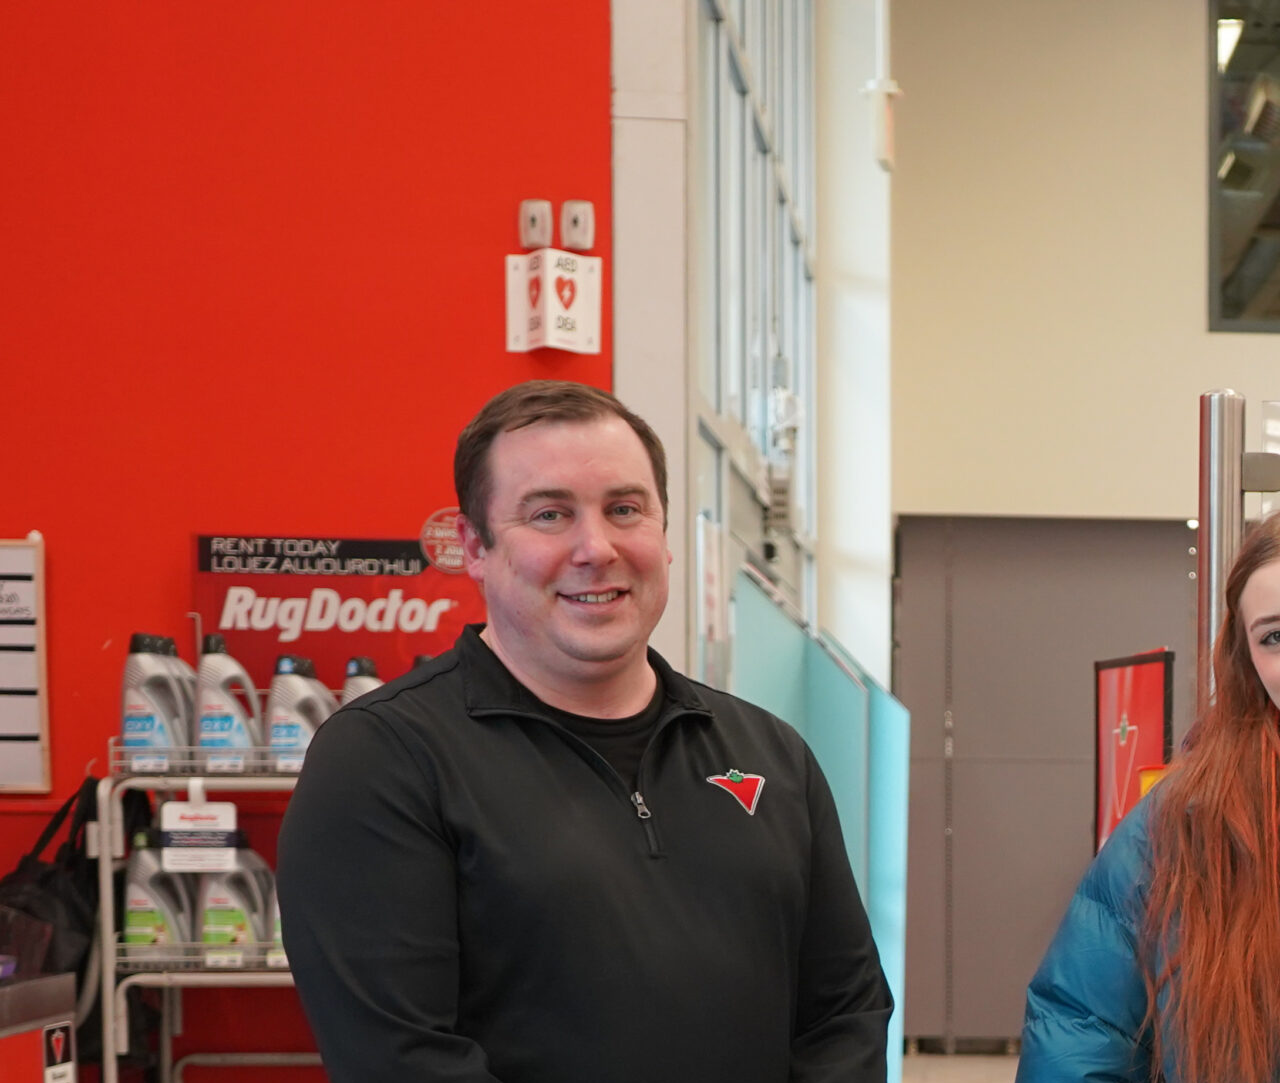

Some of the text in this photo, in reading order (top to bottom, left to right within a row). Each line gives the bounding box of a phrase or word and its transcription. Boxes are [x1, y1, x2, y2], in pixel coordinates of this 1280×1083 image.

[211, 537, 341, 556] RENT TODAY
[211, 556, 421, 576] LOUEZ AUJOURD'HUI
[219, 586, 453, 642] RugDoctor
